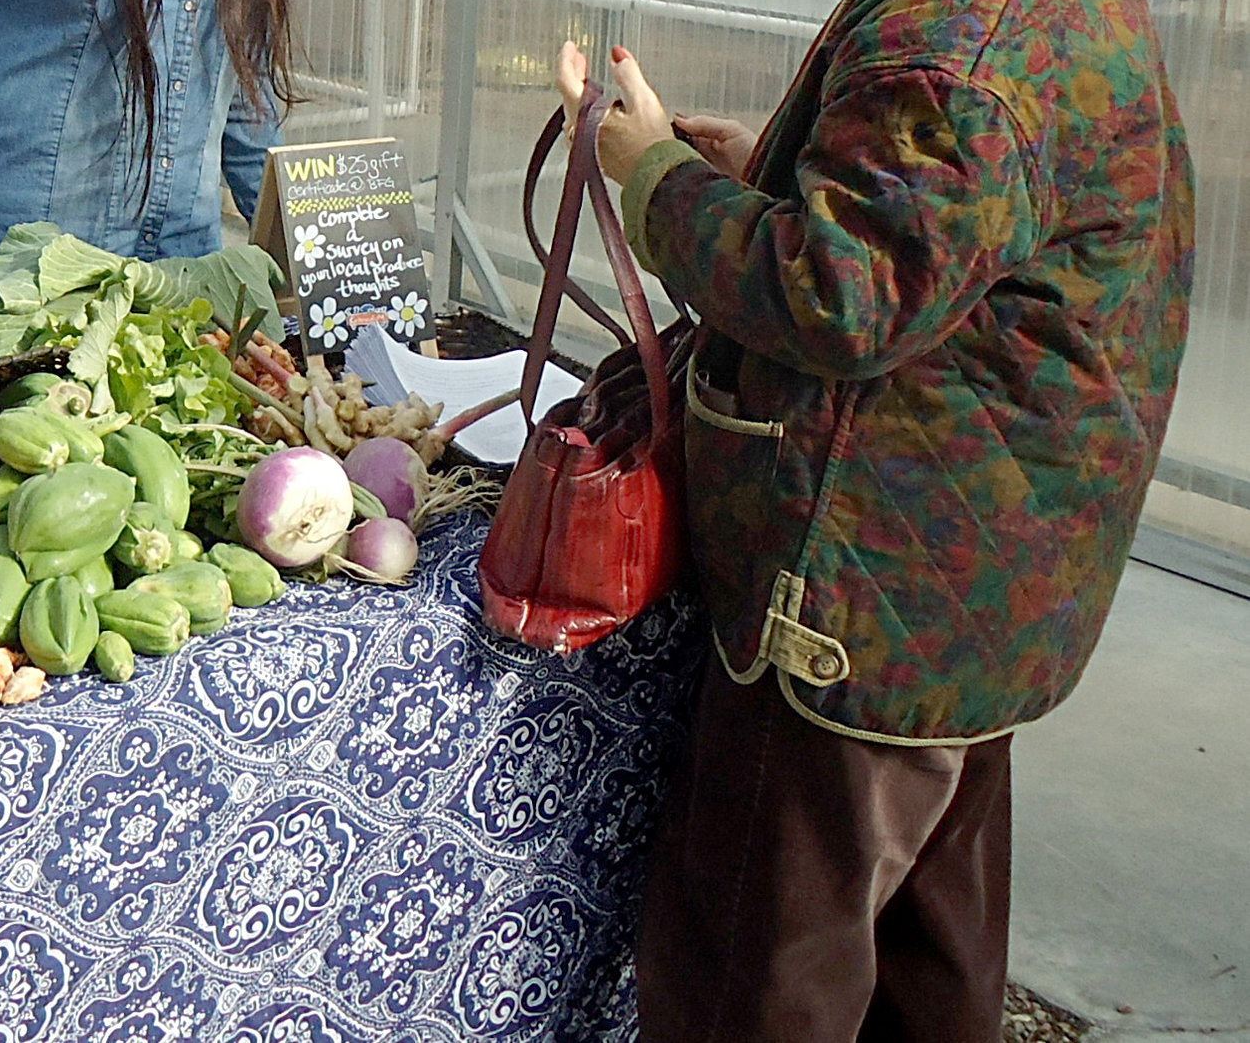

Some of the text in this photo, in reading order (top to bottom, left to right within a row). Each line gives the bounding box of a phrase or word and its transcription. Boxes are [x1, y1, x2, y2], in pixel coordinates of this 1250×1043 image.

[284, 153, 335, 182] WIN
[368, 150, 403, 179] gift
[346, 229, 365, 242] a
[382, 237, 404, 251] on
[298, 252, 424, 297] your local produce
[335, 275, 401, 301] thoughts
